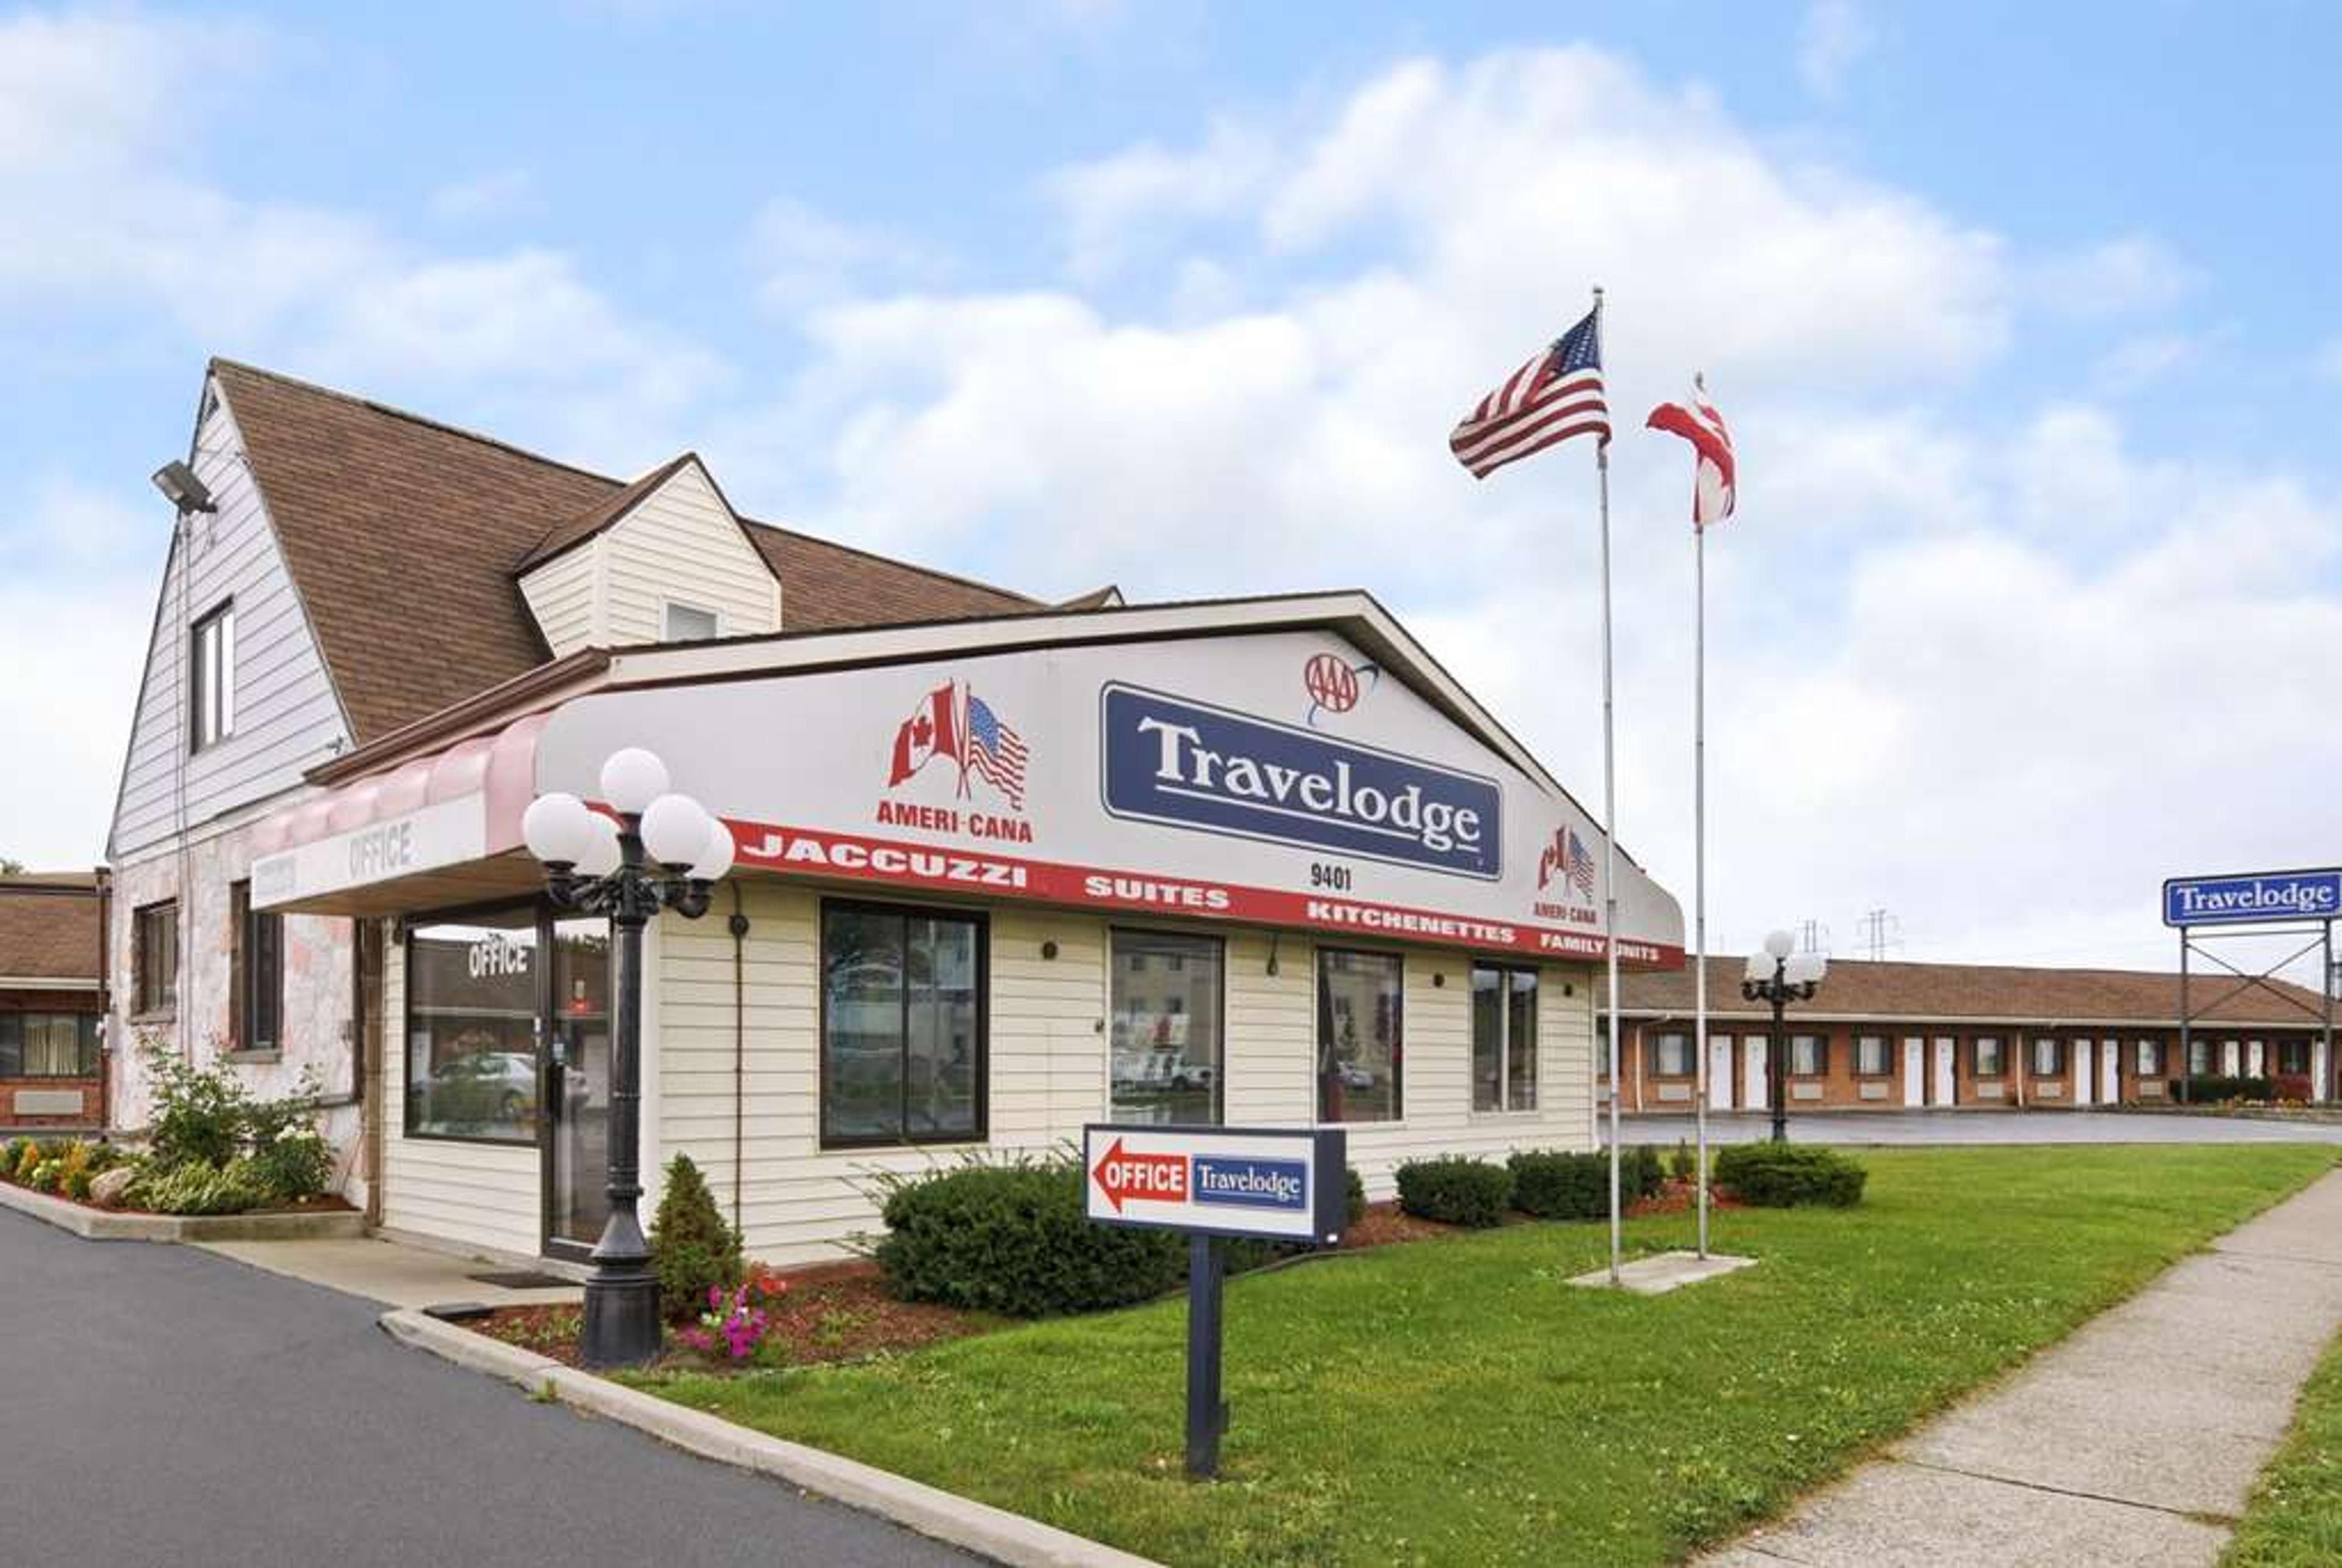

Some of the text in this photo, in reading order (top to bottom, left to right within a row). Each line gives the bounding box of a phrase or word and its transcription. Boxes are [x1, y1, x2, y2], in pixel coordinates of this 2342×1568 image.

[1138, 717, 1480, 851] Travelodge
[877, 800, 1033, 843] AMERI-CANA
[349, 822, 411, 878] OFFICE
[742, 833, 1027, 887] JACCUZZI
[1084, 876, 1230, 908] SUITES
[1307, 901, 1516, 944] KITCHENETTES
[1539, 933, 1605, 953] FAMILY
[1311, 862, 1352, 892] 9401
[2177, 882, 2333, 912] Travelodge
[469, 942, 528, 977] OFFICE
[1105, 1162, 1183, 1191] OFFICE
[1197, 1164, 1300, 1202] Travelodge
